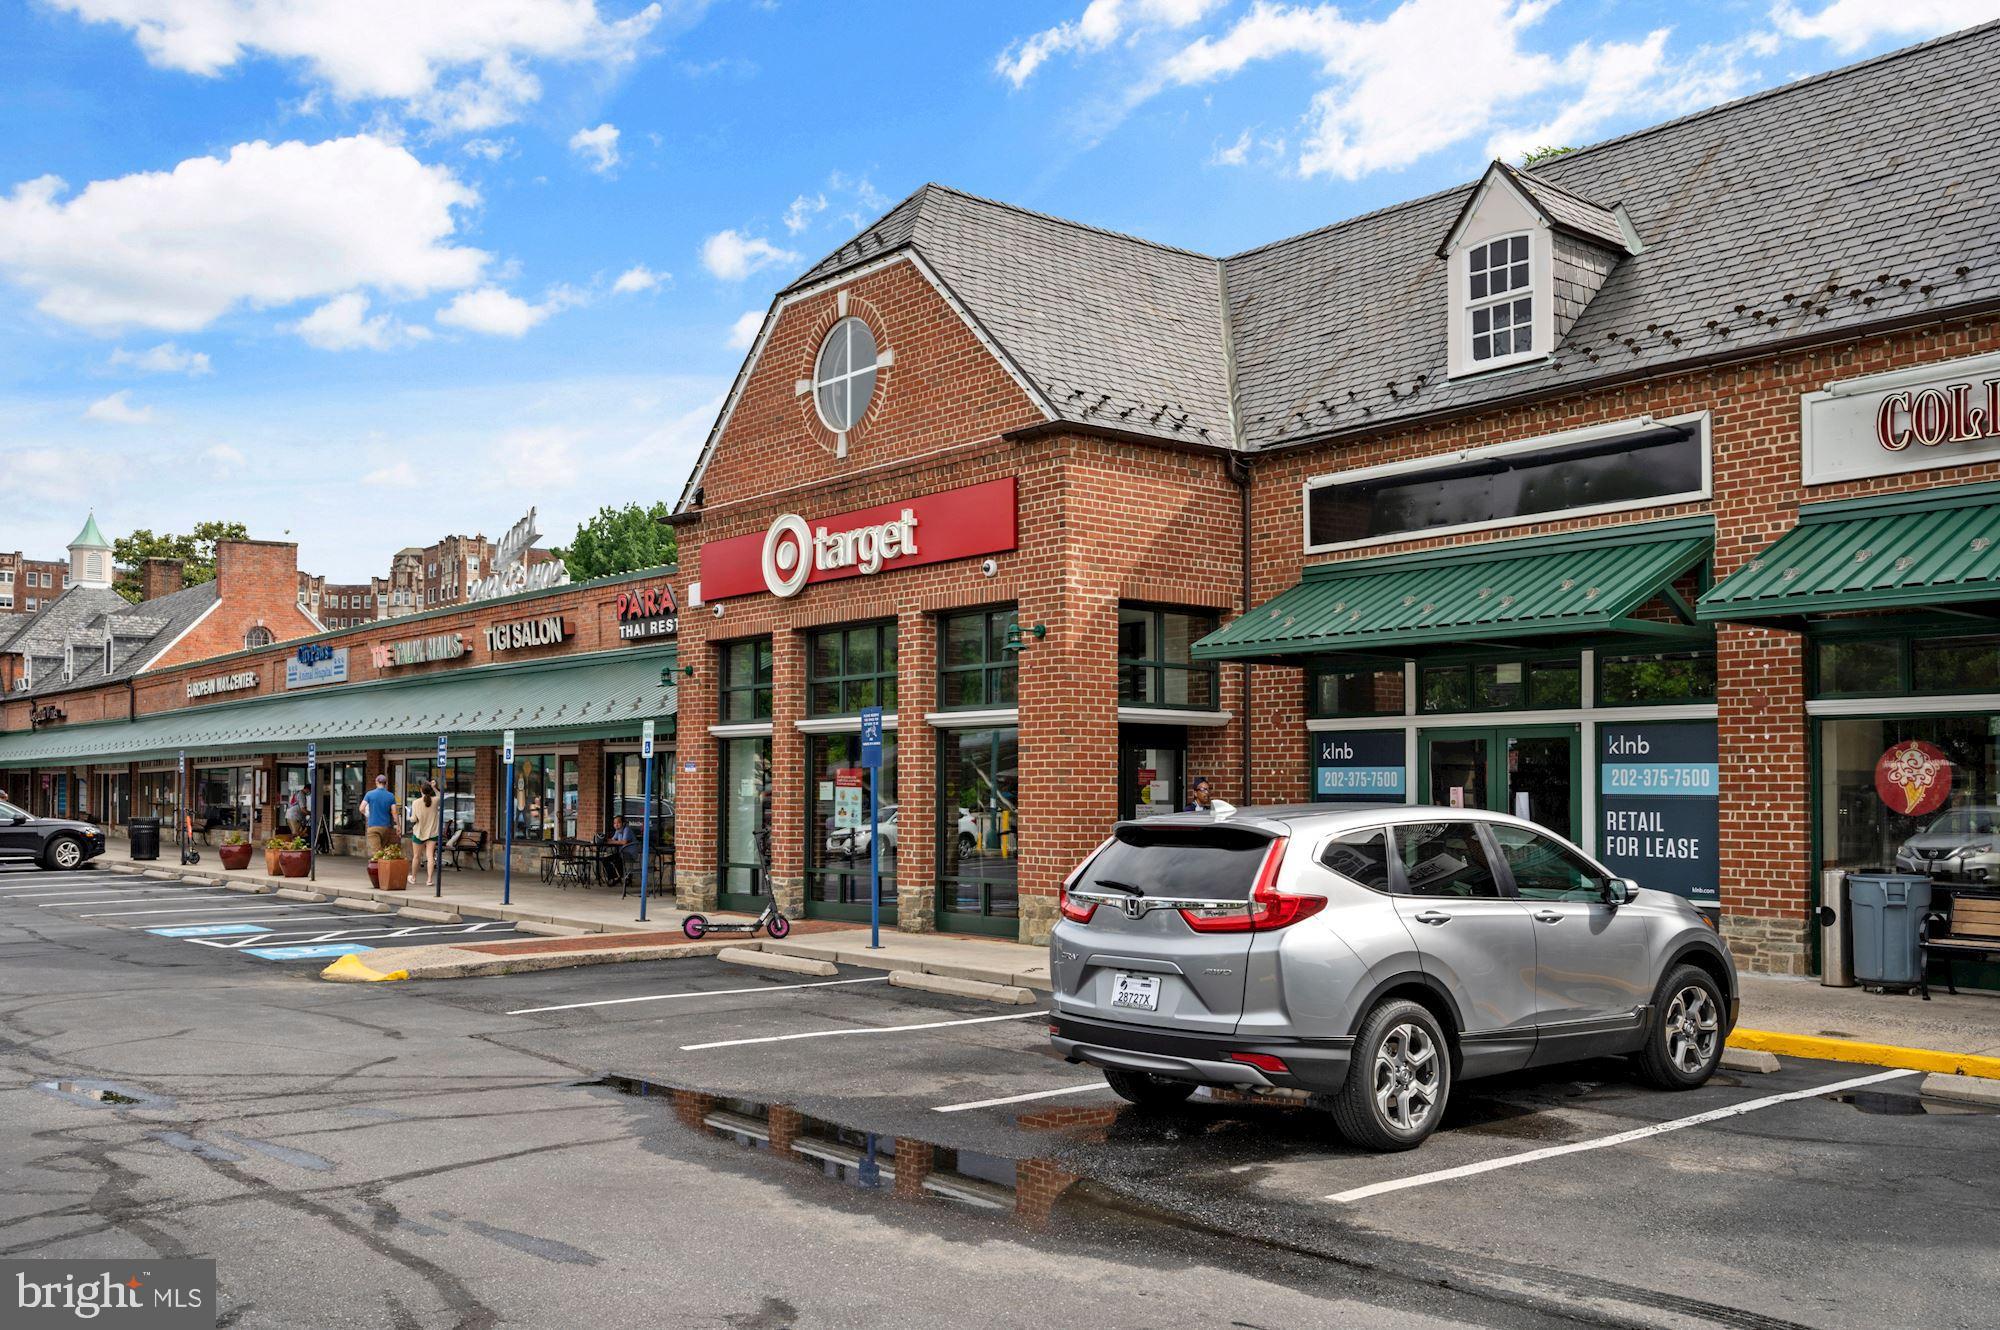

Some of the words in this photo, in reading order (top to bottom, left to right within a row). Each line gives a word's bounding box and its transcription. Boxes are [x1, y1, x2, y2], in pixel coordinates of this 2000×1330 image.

[813, 508, 918, 576] target
[617, 584, 677, 620] PARA
[483, 624, 511, 652] TIGI
[512, 616, 563, 648] SALON
[619, 623, 646, 638] THAI
[187, 679, 216, 697] EUROPEAN
[230, 671, 257, 690] CENTER
[1322, 742, 1354, 760] klnb
[1609, 735, 1651, 755] klnb
[1324, 771, 1398, 788] 202-375-7500
[1611, 768, 1710, 788] 202-375-7500
[1606, 811, 1665, 833] RETAIL
[1606, 836, 1639, 857] FOR
[1646, 838, 1699, 860] LEASE
[1202, 968, 1233, 977] AWD
[1118, 991, 1151, 1005] 28727X
